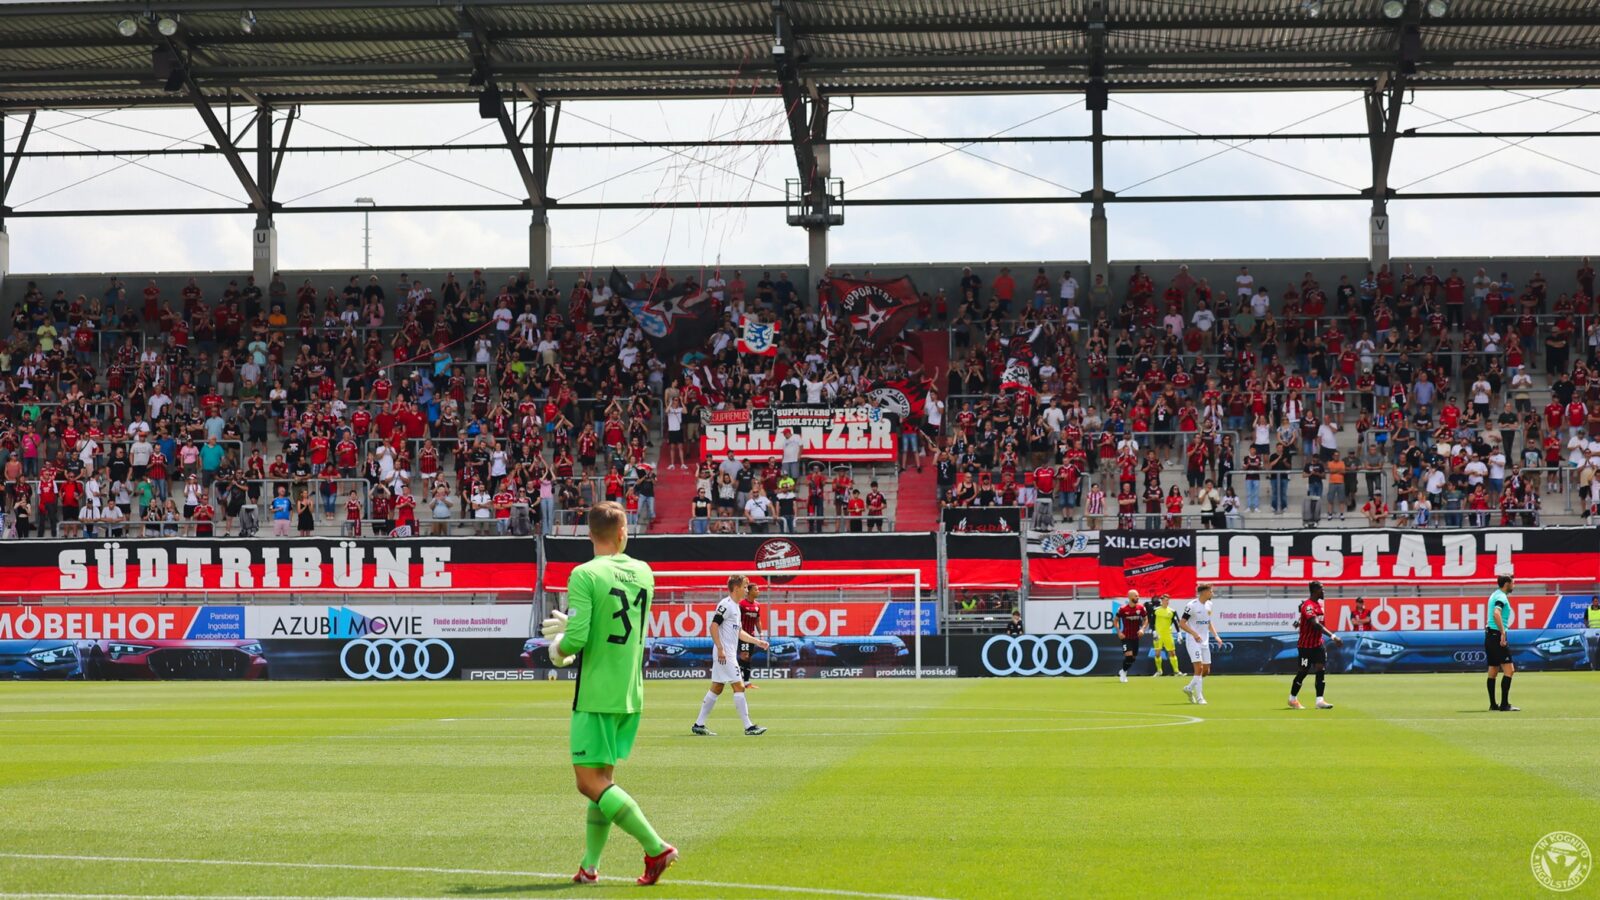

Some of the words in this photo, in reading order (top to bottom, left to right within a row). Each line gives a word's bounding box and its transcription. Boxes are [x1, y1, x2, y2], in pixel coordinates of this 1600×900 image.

[1376, 219, 1385, 230] V
[257, 232, 266, 243] U
[776, 408, 830, 417] SUPPORTERS
[778, 418, 830, 426] INGOLSTADT
[705, 421, 893, 451] SCHANZER
[1104, 534, 1191, 550] XII.LEGION
[58, 541, 453, 590] SÜDTRIBÜNE
[210, 612, 240, 621] Parsberg
[433, 617, 451, 625] Finde
[451, 617, 470, 625] deine
[470, 617, 508, 626] Ausbildung!
[607, 587, 648, 645] 31
[1053, 611, 1114, 631] AZUB
[1257, 612, 1296, 620] Ausbildung!
[208, 622, 240, 631] Ingolstadt
[271, 616, 338, 636] AZUBI
[350, 616, 423, 636] MOVIE
[645, 669, 707, 679] hildeGUARD
[820, 667, 864, 679] guSTAFF
